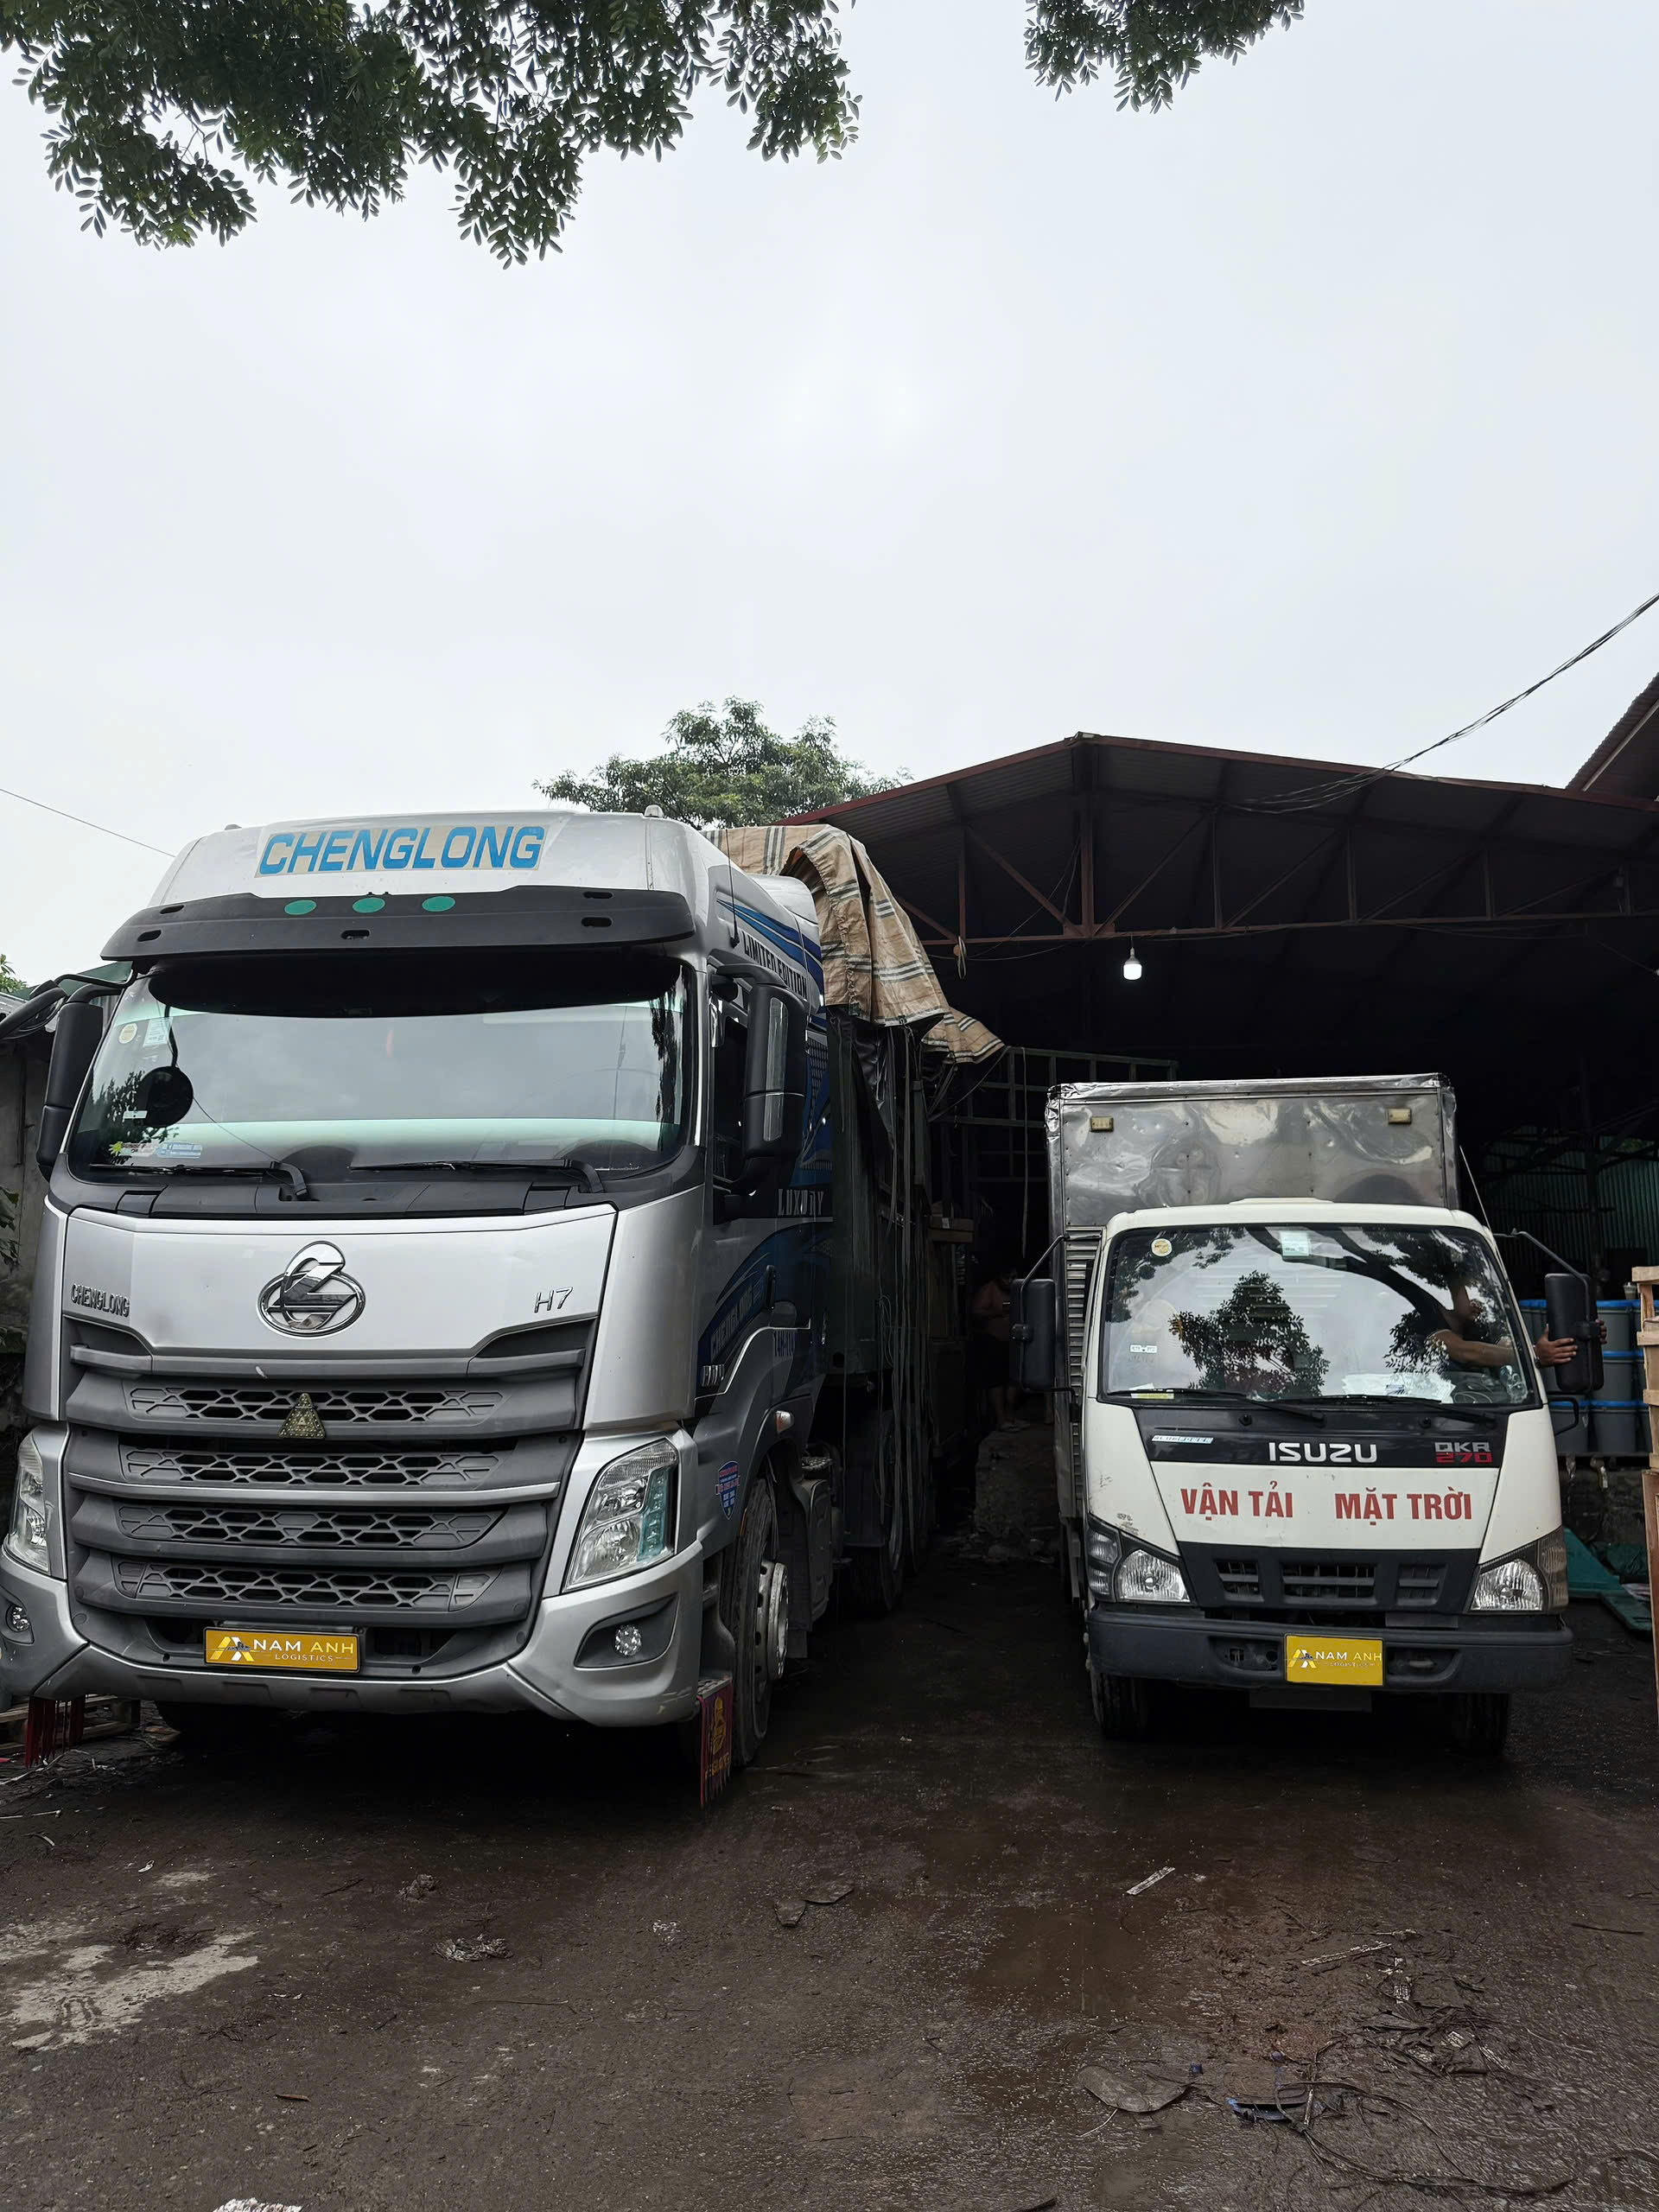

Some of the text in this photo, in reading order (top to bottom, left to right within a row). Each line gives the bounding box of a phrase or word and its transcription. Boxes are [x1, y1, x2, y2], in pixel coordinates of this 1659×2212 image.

[258, 826, 546, 875] CHENGLONG
[741, 930, 808, 1000] LIMITED EDITION
[778, 1188, 824, 1217] LUXURY
[71, 1283, 130, 1318] CHENGLONG
[534, 1287, 574, 1313] H7
[1268, 1441, 1378, 1463] ISUZU
[1434, 1441, 1491, 1452] QKR
[1435, 1452, 1493, 1463] 270
[1179, 1480, 1472, 1526] VẬN TẢI MẶT TRỜI
